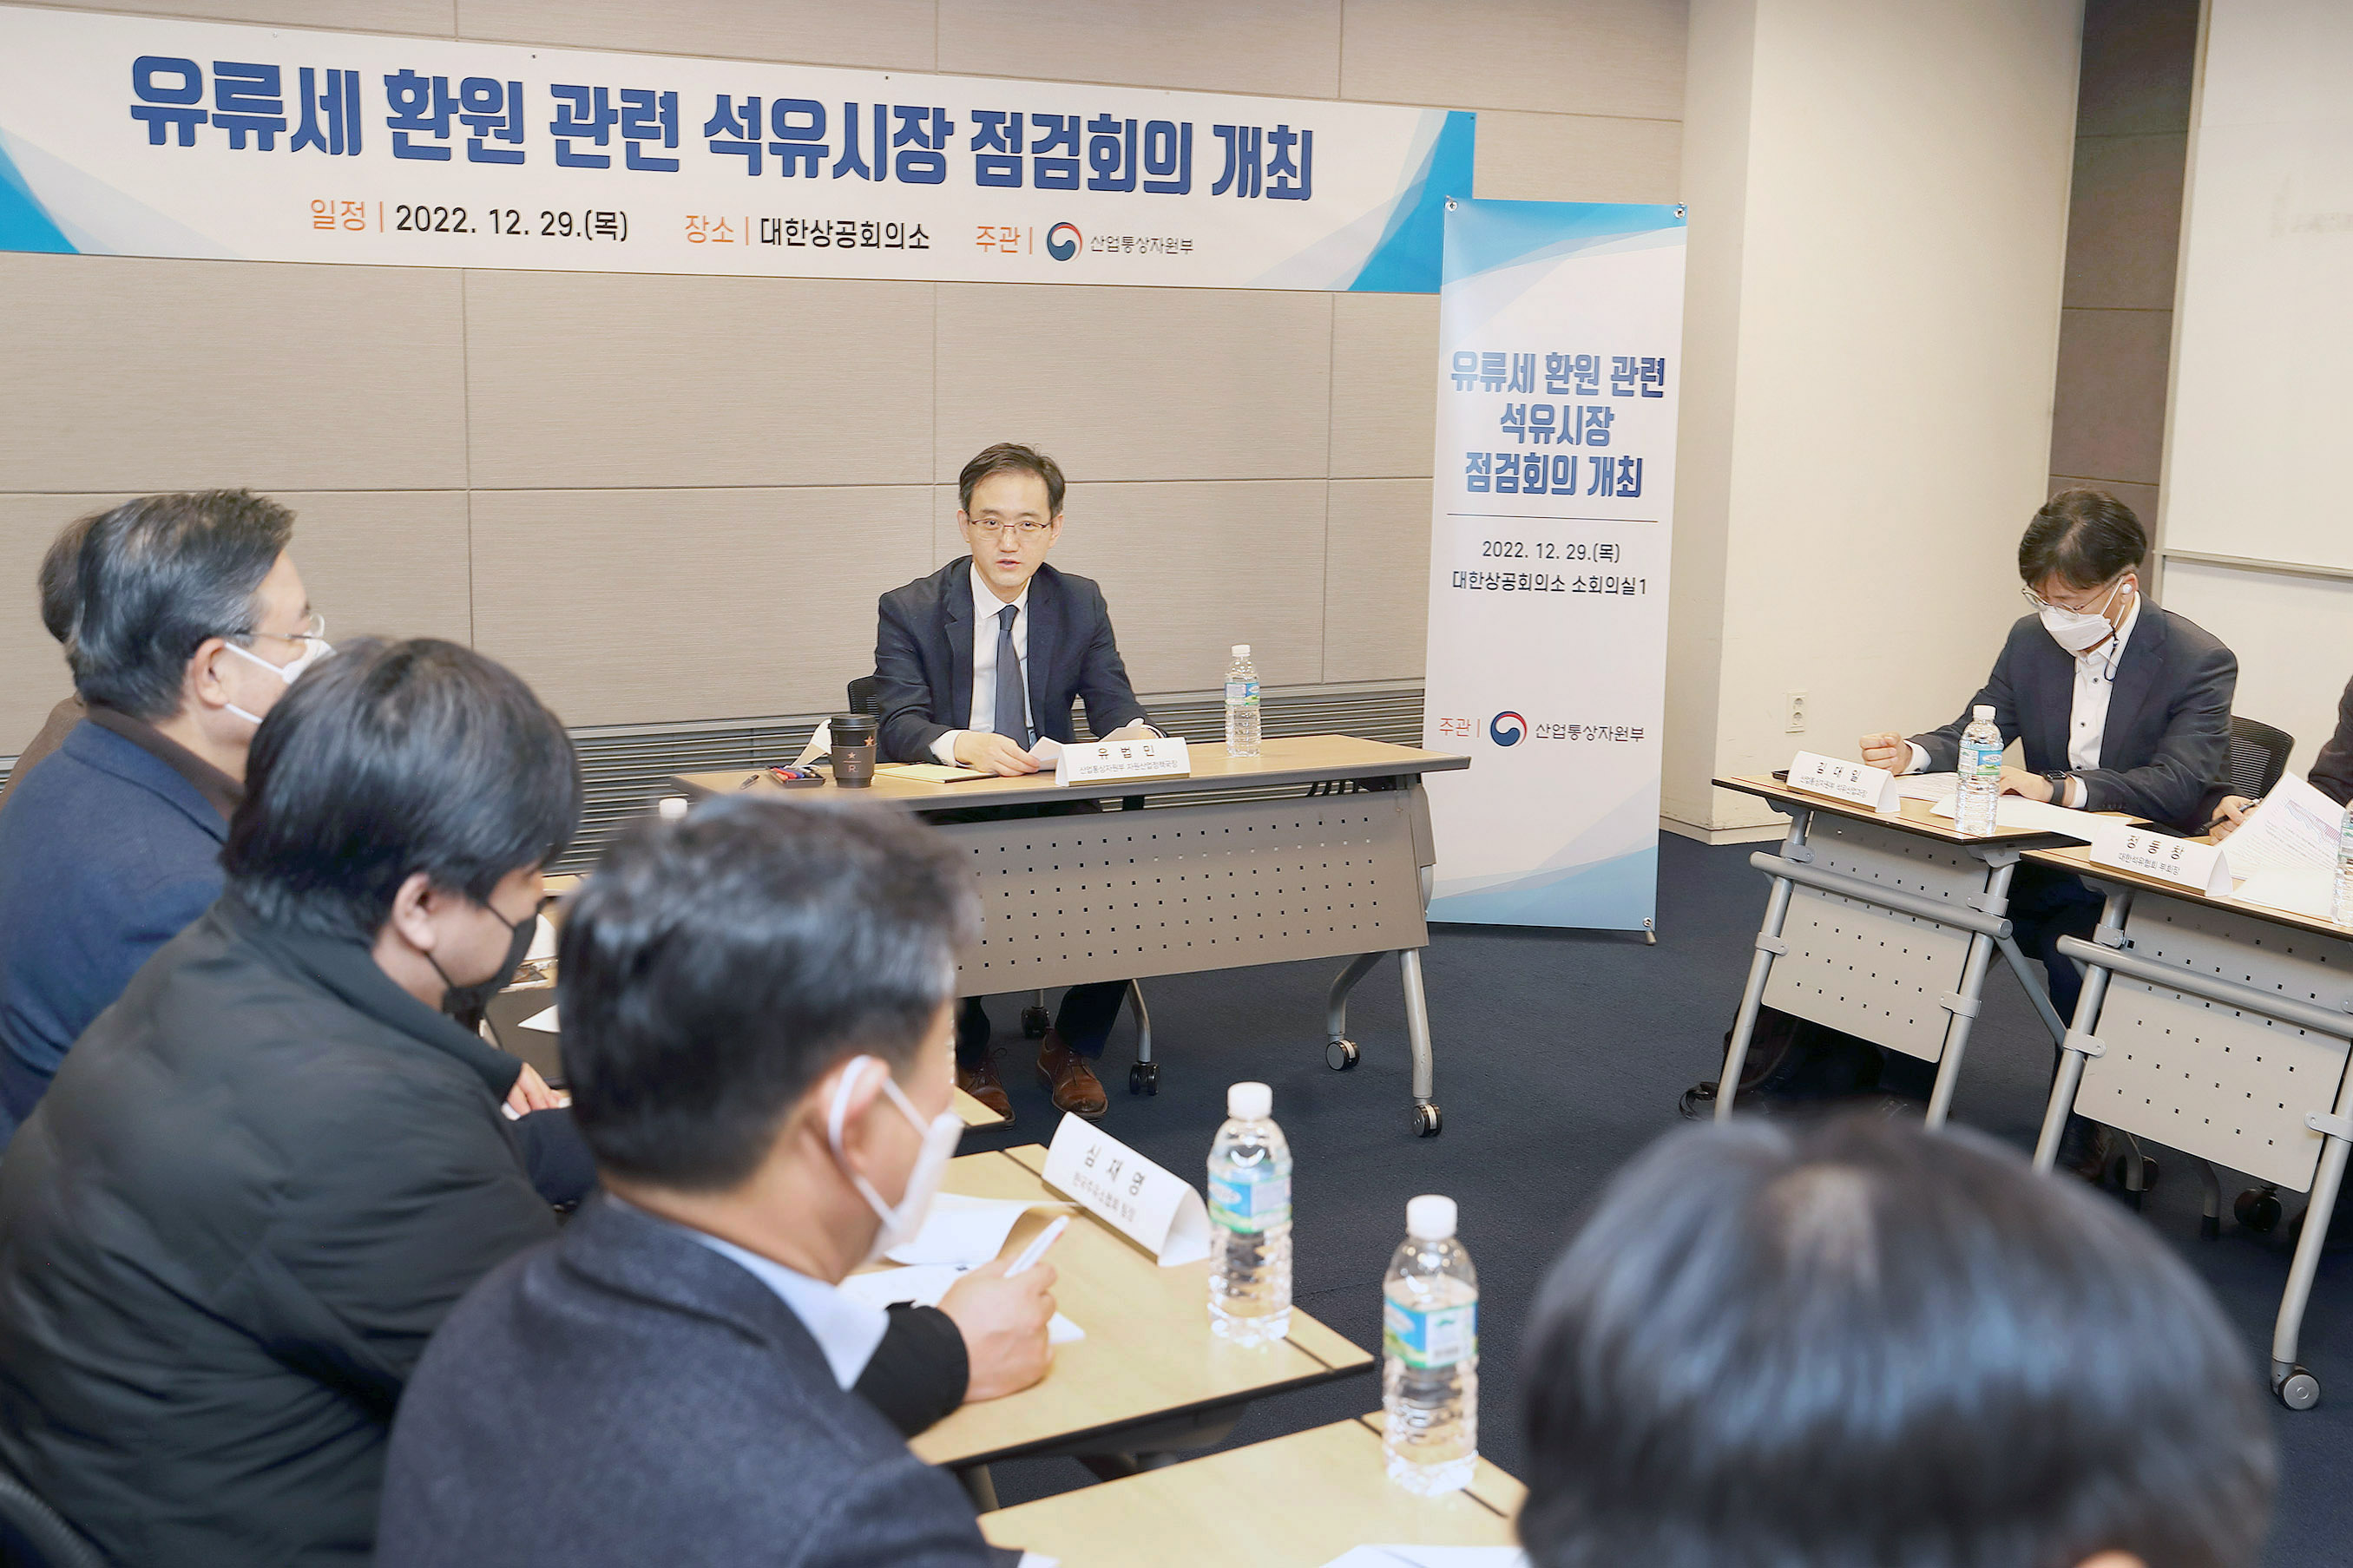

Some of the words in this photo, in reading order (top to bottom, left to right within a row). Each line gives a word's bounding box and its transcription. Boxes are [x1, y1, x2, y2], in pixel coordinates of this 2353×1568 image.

[130, 56, 362, 156] 유류세
[384, 69, 525, 165] 환원
[549, 84, 680, 173] 관련
[704, 94, 956, 185] 석유시장
[970, 110, 1193, 195] 점검회의
[1211, 124, 1313, 201] 개최
[311, 199, 366, 232] 일정
[396, 205, 477, 233] 2022.
[489, 209, 529, 235] 12.
[540, 209, 628, 242] 29.(목)
[685, 215, 734, 245] 장소
[760, 217, 930, 251] 대한상공회의소
[976, 226, 1022, 254] 주관
[1091, 235, 1194, 255] 산업통상자원부
[1450, 351, 1536, 394] 유류세
[1545, 351, 1600, 397] 환원
[1610, 356, 1666, 398] 관련
[1500, 403, 1615, 447] 석유시장
[1465, 451, 1578, 495] 점검회의
[1587, 455, 1643, 498] 개최
[1482, 541, 1528, 559] 2022.
[1536, 542, 1560, 560] 12.
[1566, 542, 1620, 564] 29.(목)
[1452, 570, 1566, 593] 대한상공회의소
[1572, 574, 1646, 596] 소회의실1
[1439, 718, 1472, 738] 주관
[1535, 723, 1645, 743] 산업통상자원부
